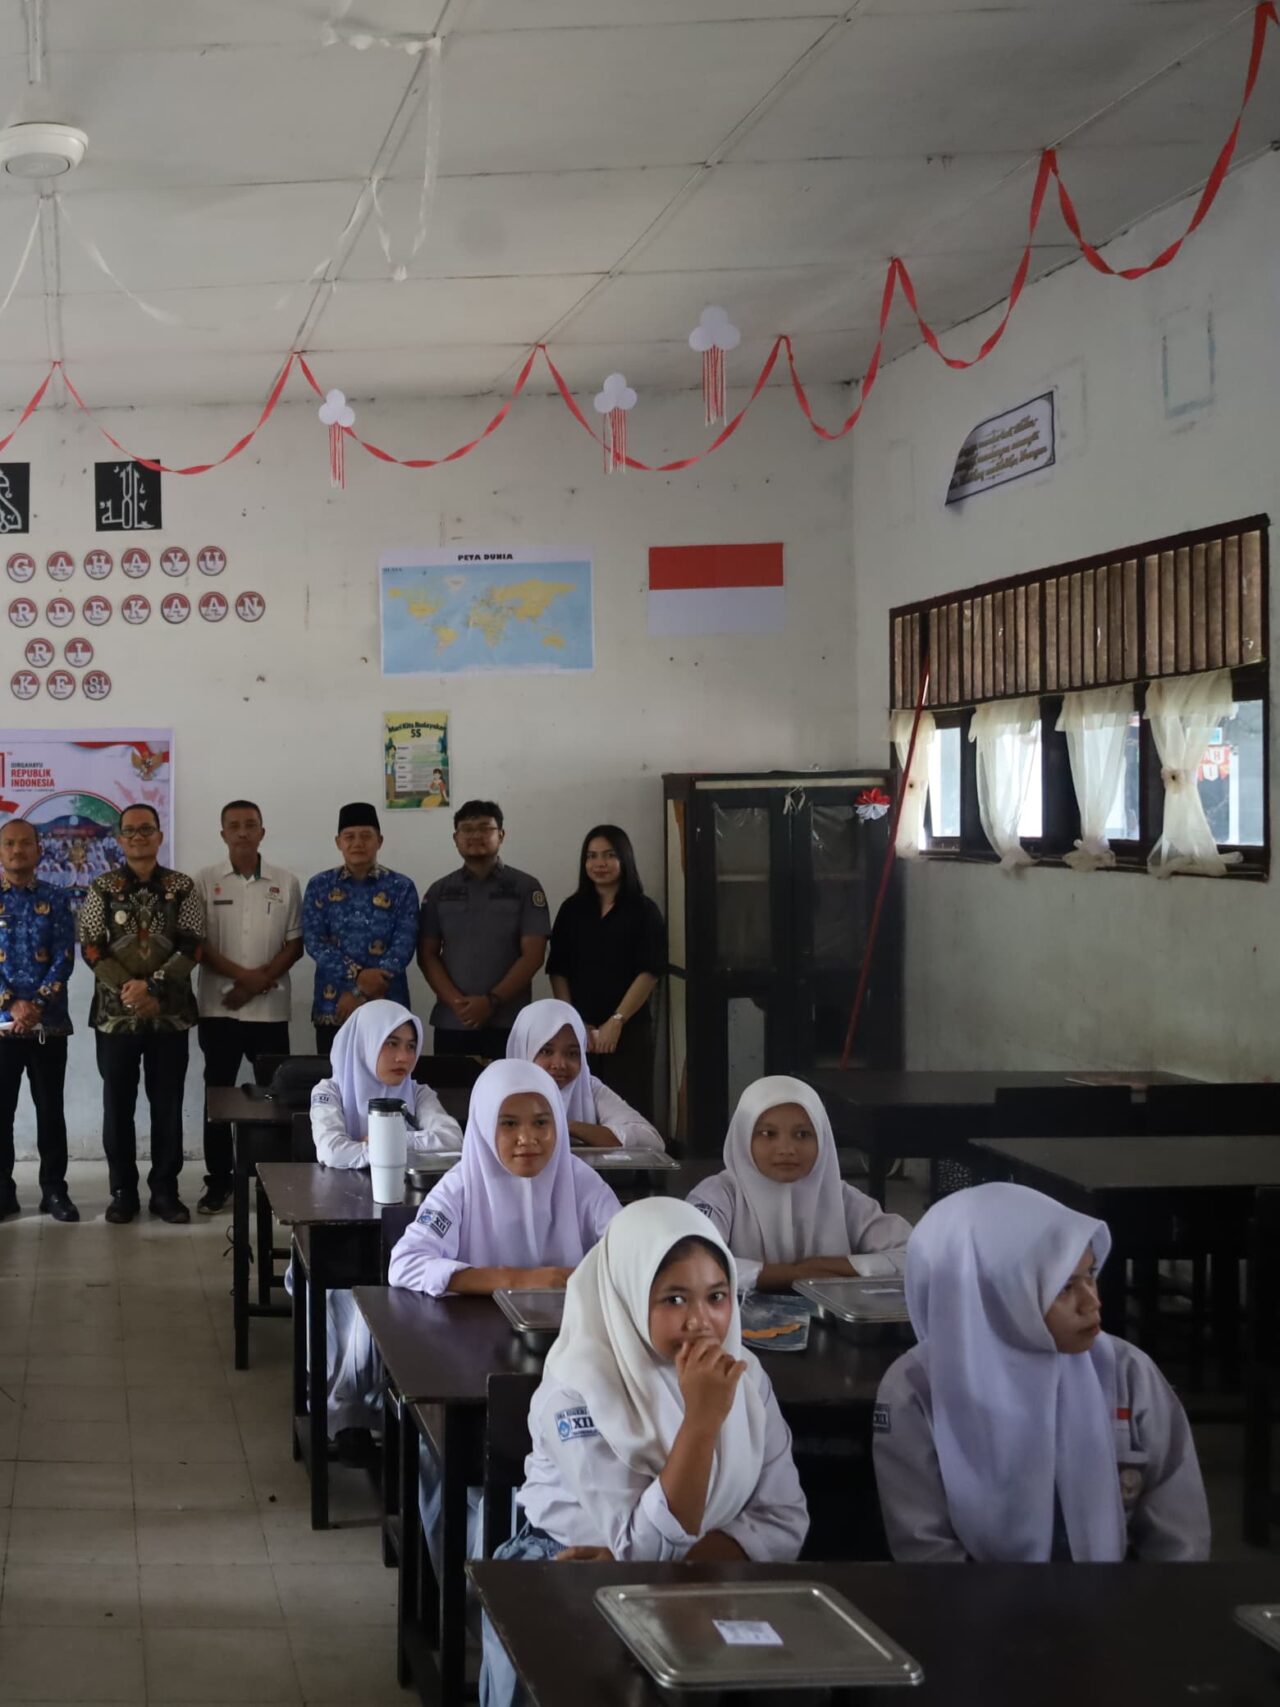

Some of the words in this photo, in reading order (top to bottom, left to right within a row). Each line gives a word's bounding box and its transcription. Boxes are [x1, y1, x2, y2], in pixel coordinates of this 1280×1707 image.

[483, 553, 513, 561] DUNIA
[11, 768, 51, 778] REPUBLIK
[11, 778, 55, 787] INDONESIA
[572, 1416, 594, 1429] XII
